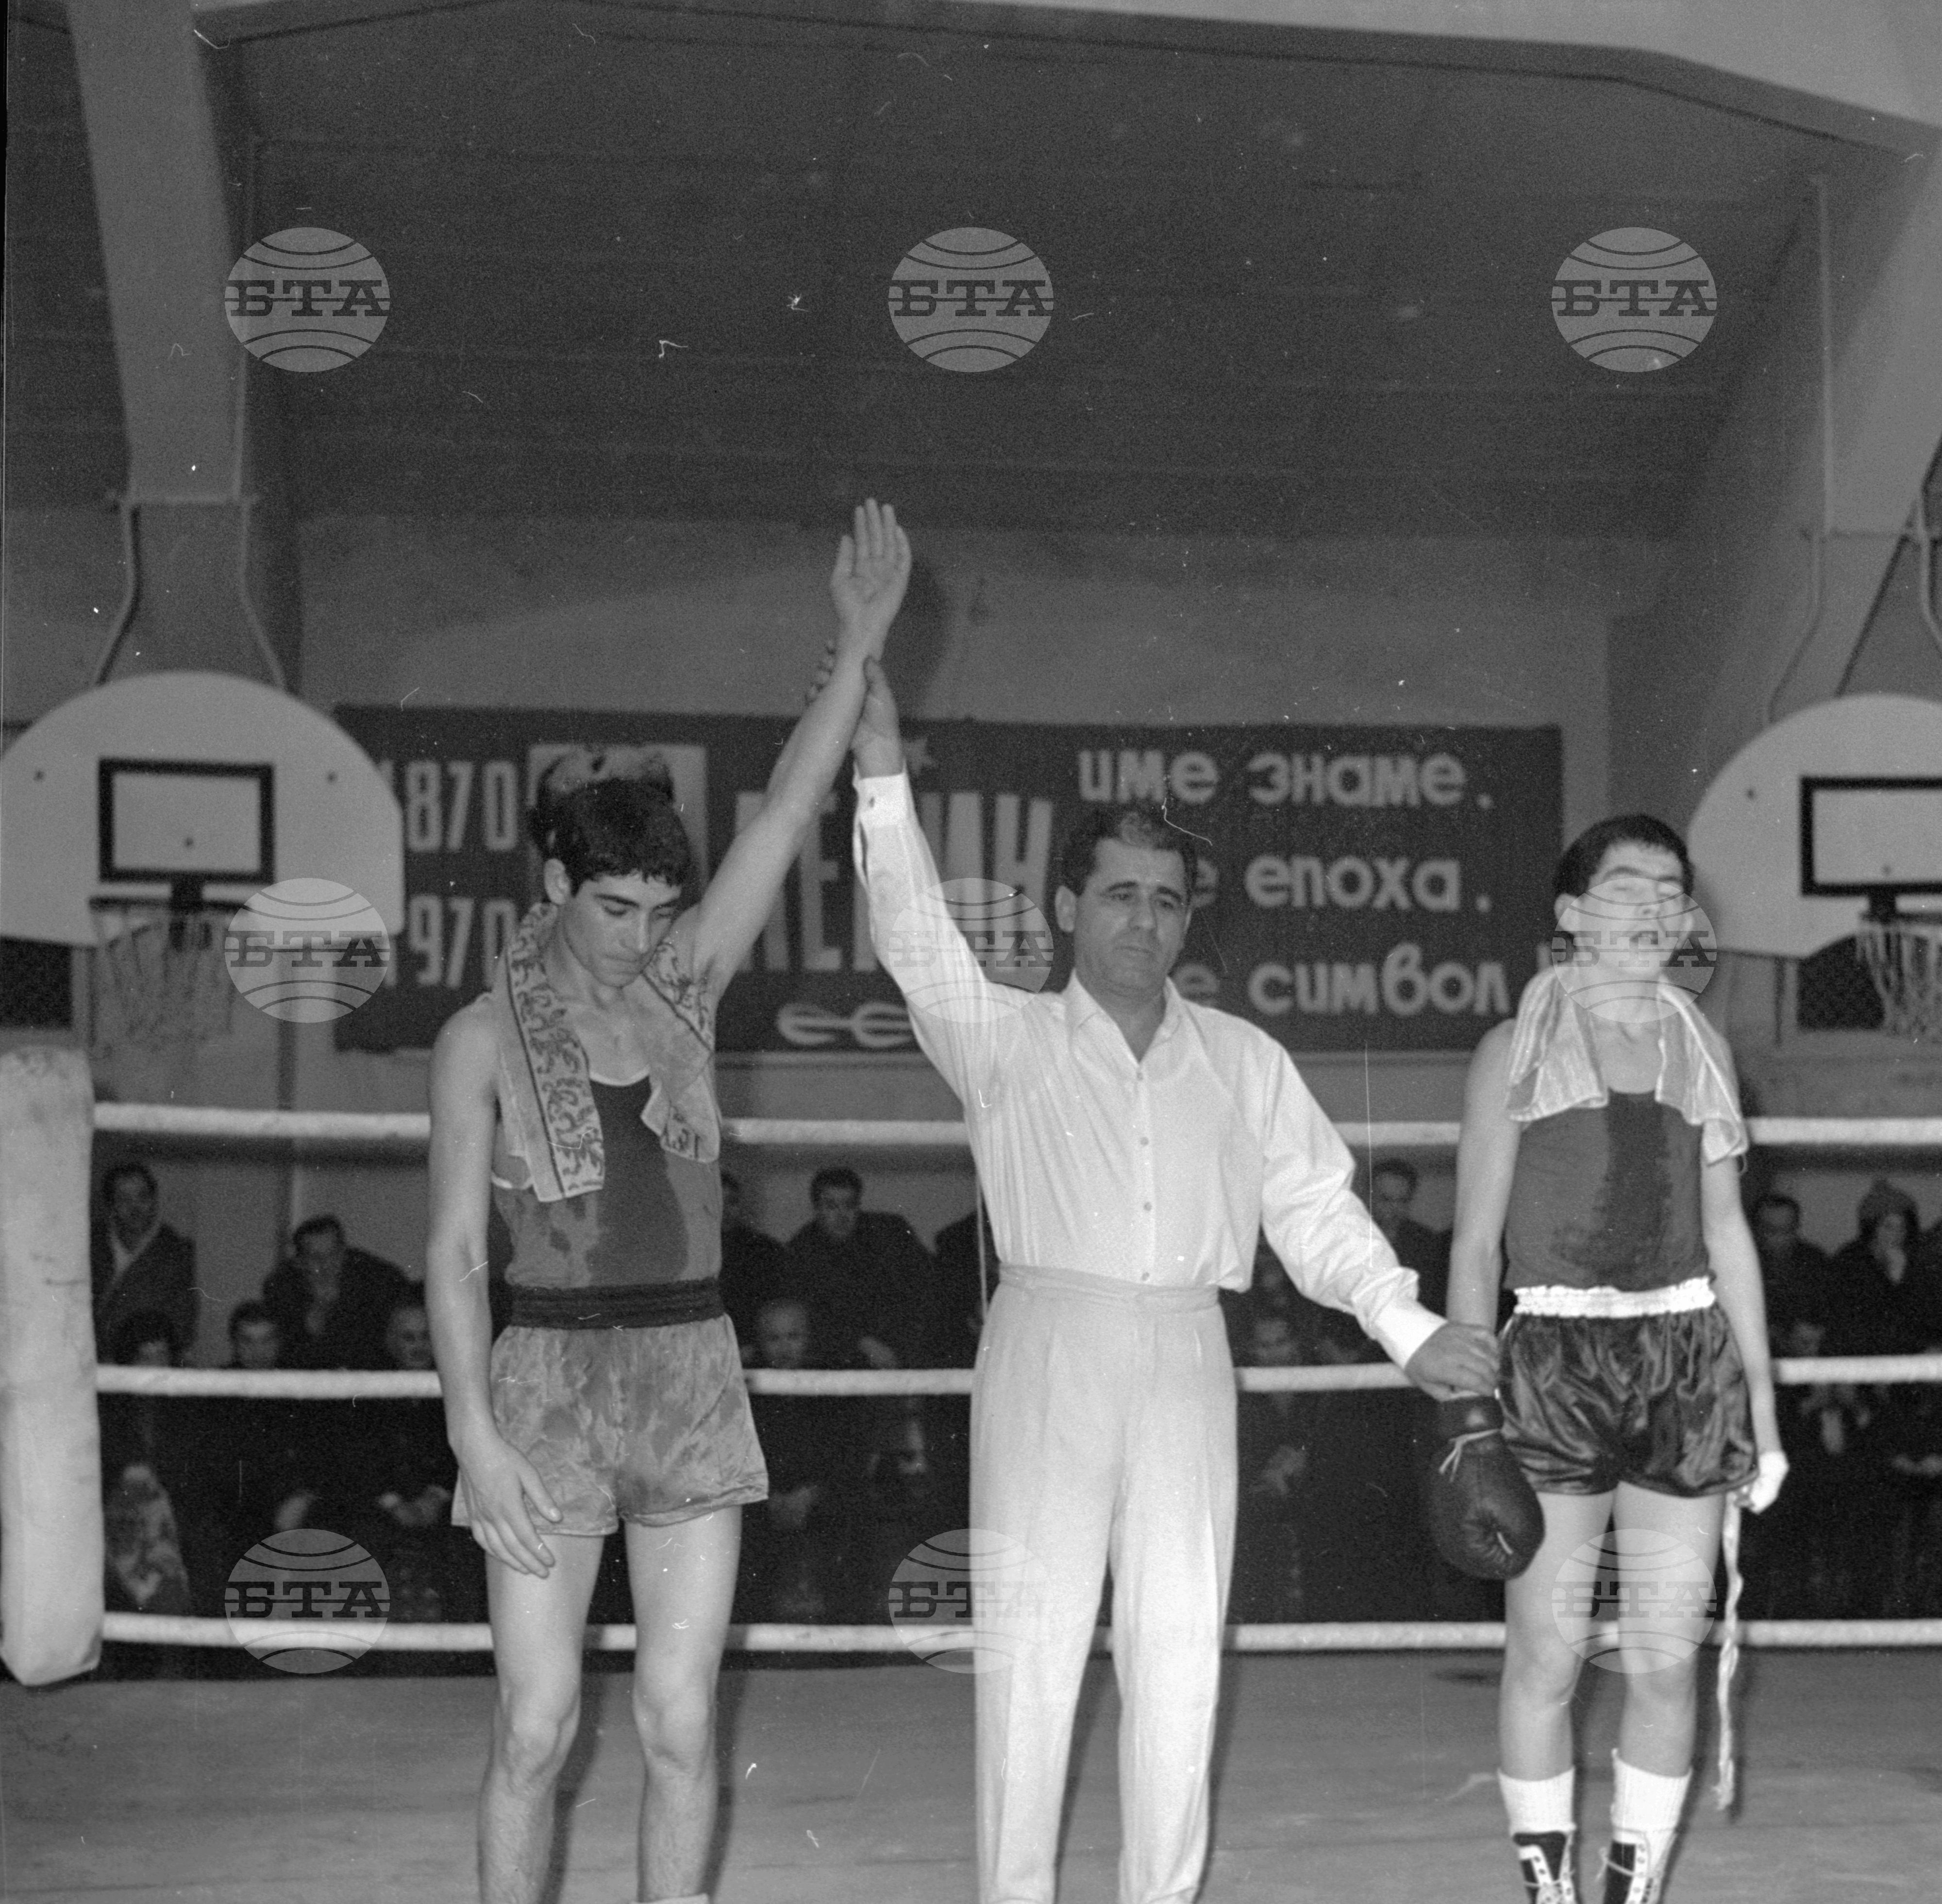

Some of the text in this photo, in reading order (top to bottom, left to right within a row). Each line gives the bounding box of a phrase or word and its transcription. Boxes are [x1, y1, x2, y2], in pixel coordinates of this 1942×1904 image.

[1078, 751, 1493, 809] име знаме.
[736, 792, 1053, 971] ЕИН
[1244, 855, 1491, 911] епоха.
